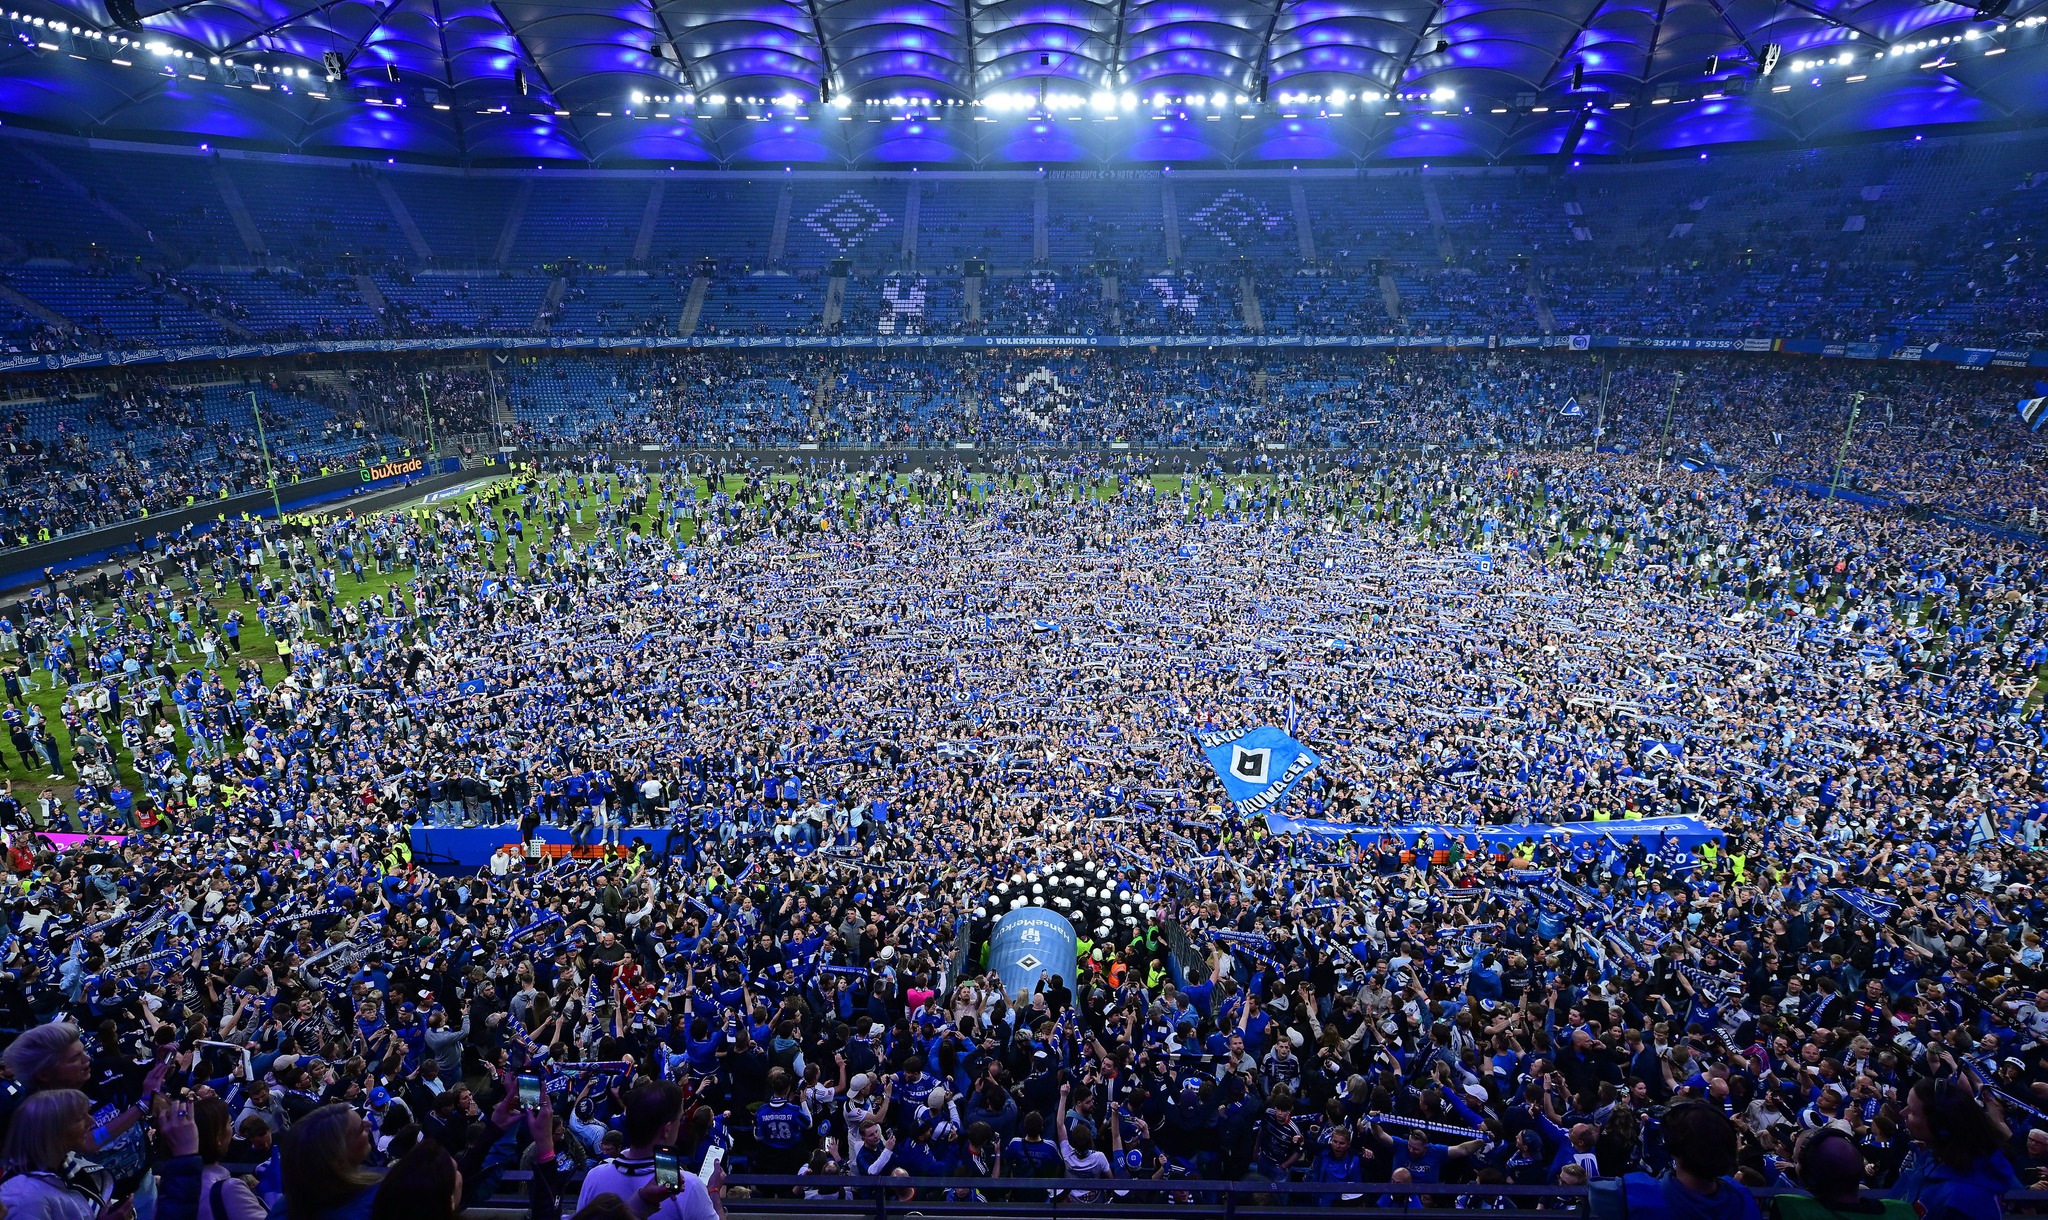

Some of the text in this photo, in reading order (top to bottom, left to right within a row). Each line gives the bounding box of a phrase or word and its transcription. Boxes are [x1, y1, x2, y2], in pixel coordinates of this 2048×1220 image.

[996, 337, 1088, 346] VOLKSPARKSTADION
[371, 458, 423, 481] buXtrade
[995, 919, 1070, 943] HanseMerkur
[761, 1114, 787, 1123] HAMBURGER
[768, 1121, 792, 1140] 18
